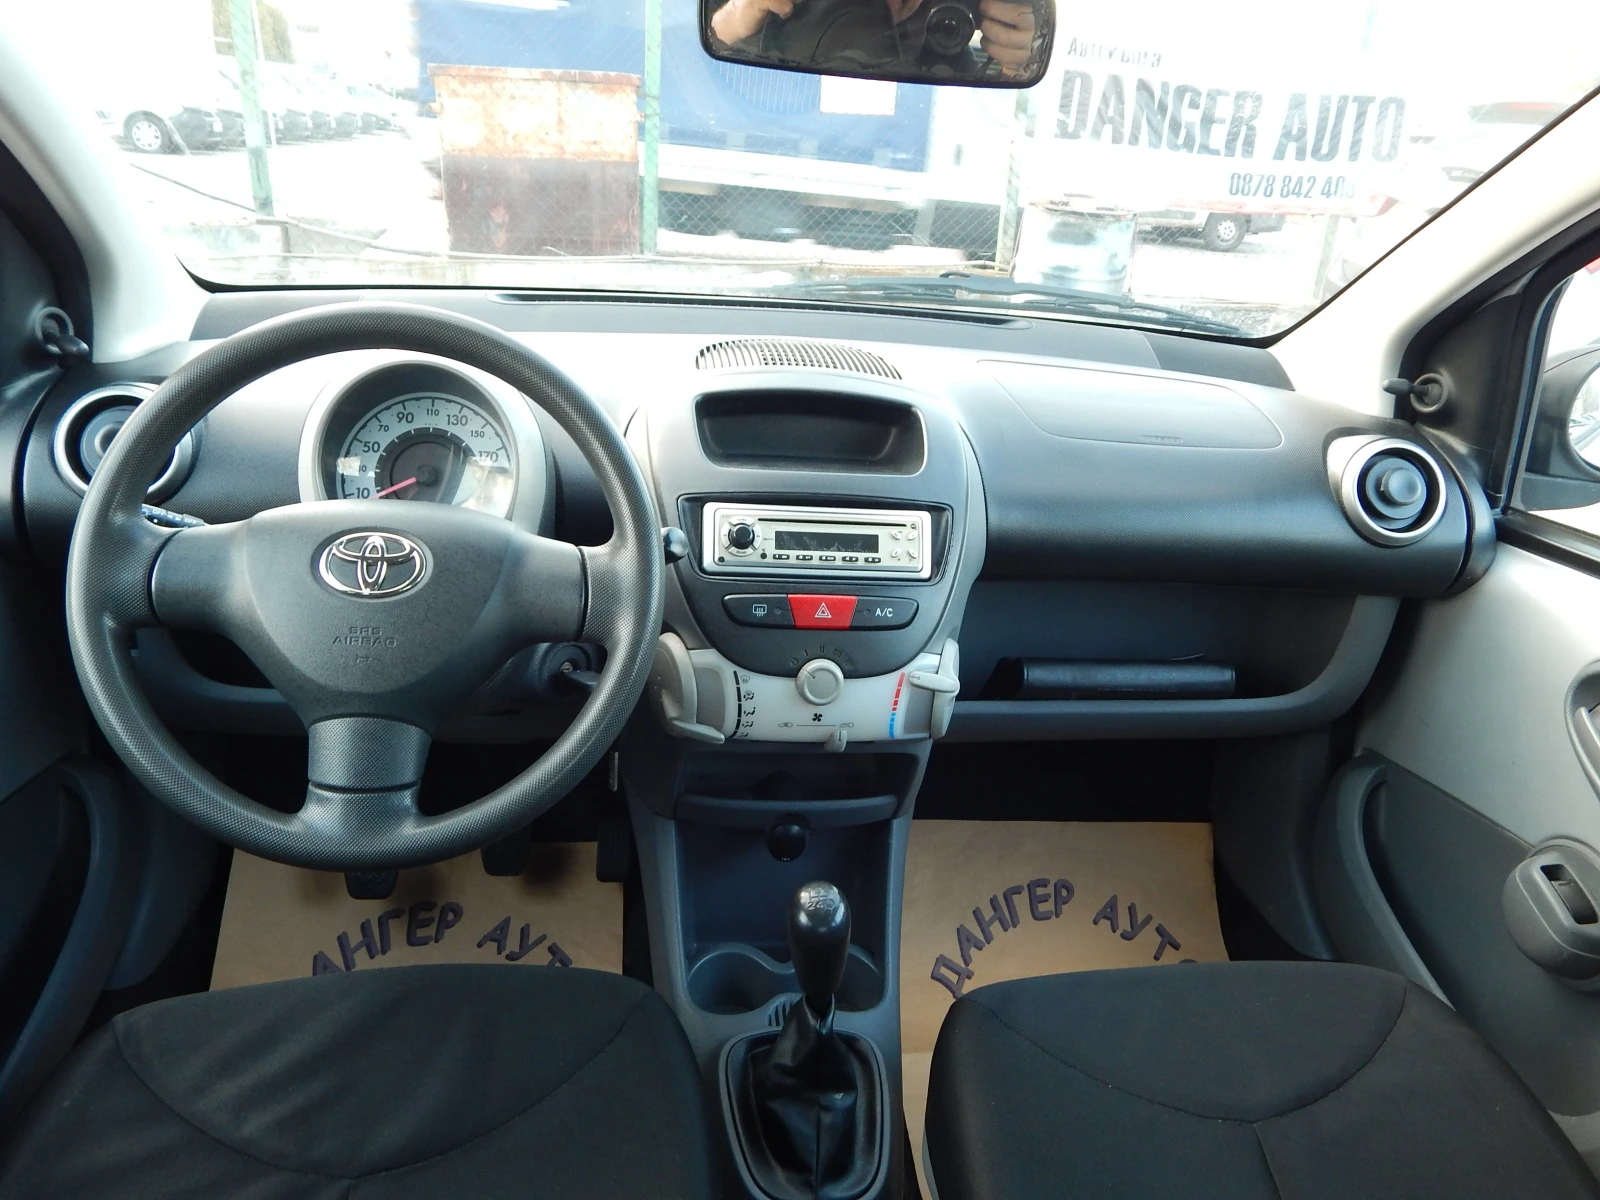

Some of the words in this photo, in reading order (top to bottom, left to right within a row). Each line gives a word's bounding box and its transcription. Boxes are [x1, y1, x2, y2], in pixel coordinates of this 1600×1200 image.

[1054, 69, 1262, 158] DANGER
[1272, 91, 1406, 163] AUTO
[1229, 172, 1276, 198] 0878
[1279, 175, 1317, 199] 842
[396, 411, 415, 424] 90
[426, 408, 440, 417] 110
[446, 414, 468, 427] 130
[378, 424, 390, 433] 70
[470, 430, 485, 438] 150
[362, 441, 381, 453] 50
[478, 450, 499, 463] 170
[356, 487, 371, 499] 10
[875, 607, 894, 618] A/C
[350, 626, 382, 636] SRS
[332, 635, 397, 649] AIRBAG
[930, 878, 1075, 1000] ДАНГЕР
[1092, 894, 1198, 964] АУТ
